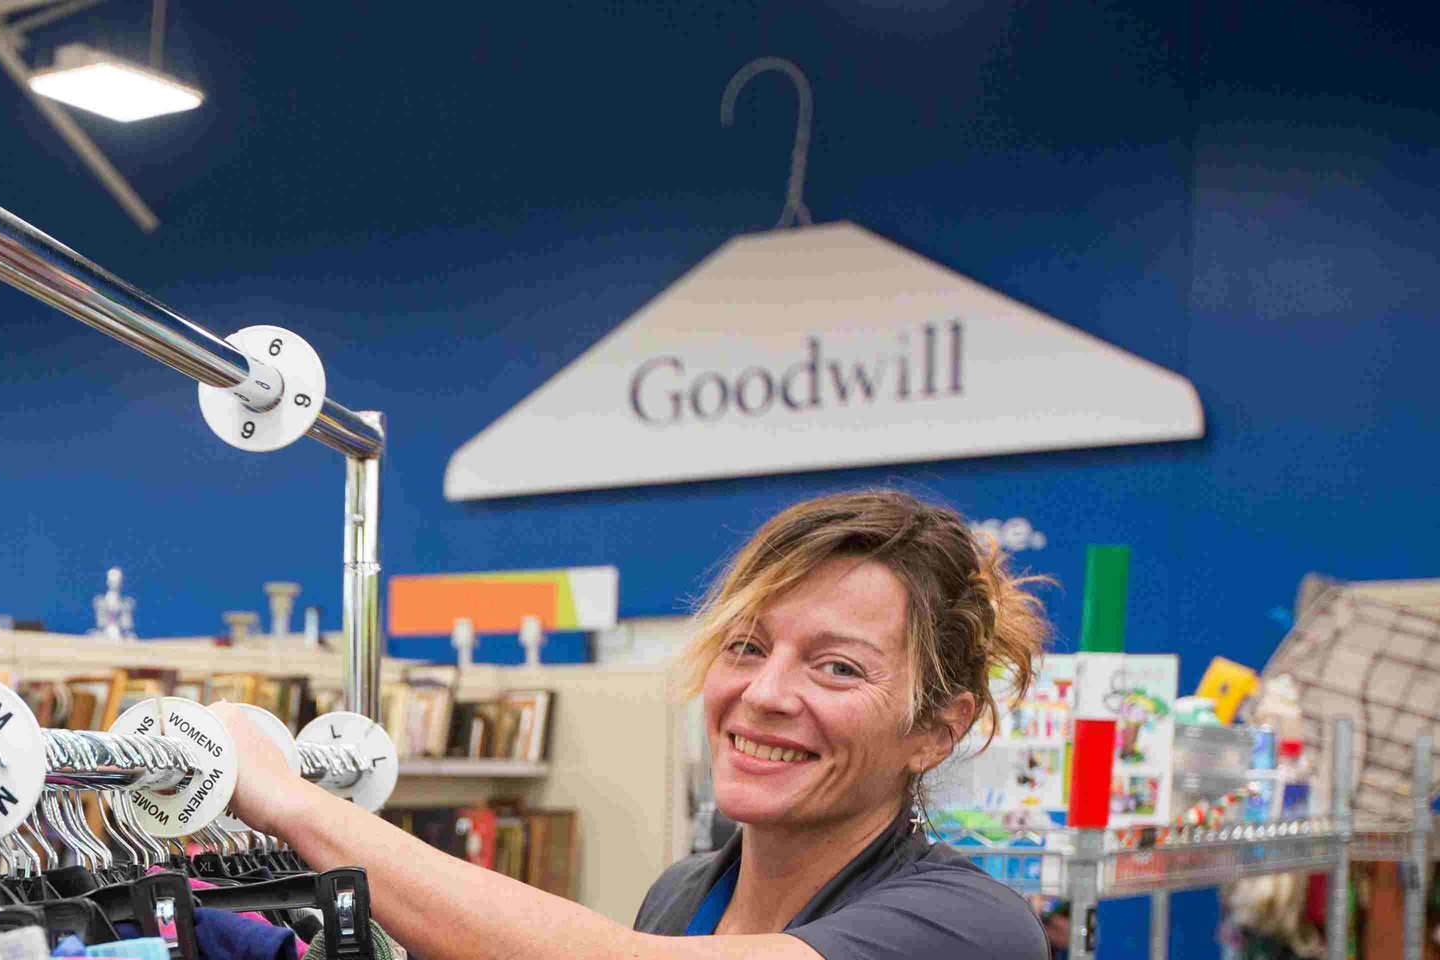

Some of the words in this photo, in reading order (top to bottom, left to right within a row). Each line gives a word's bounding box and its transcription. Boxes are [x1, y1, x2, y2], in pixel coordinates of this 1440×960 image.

[269, 338, 283, 356] 6
[628, 318, 965, 425] Goodwill
[168, 712, 223, 758] WOMENS
[330, 724, 342, 739] L
[372, 756, 387, 768] L
[131, 790, 170, 826] WOME
[178, 768, 223, 824] WOMENS
[200, 862, 215, 872] XL
